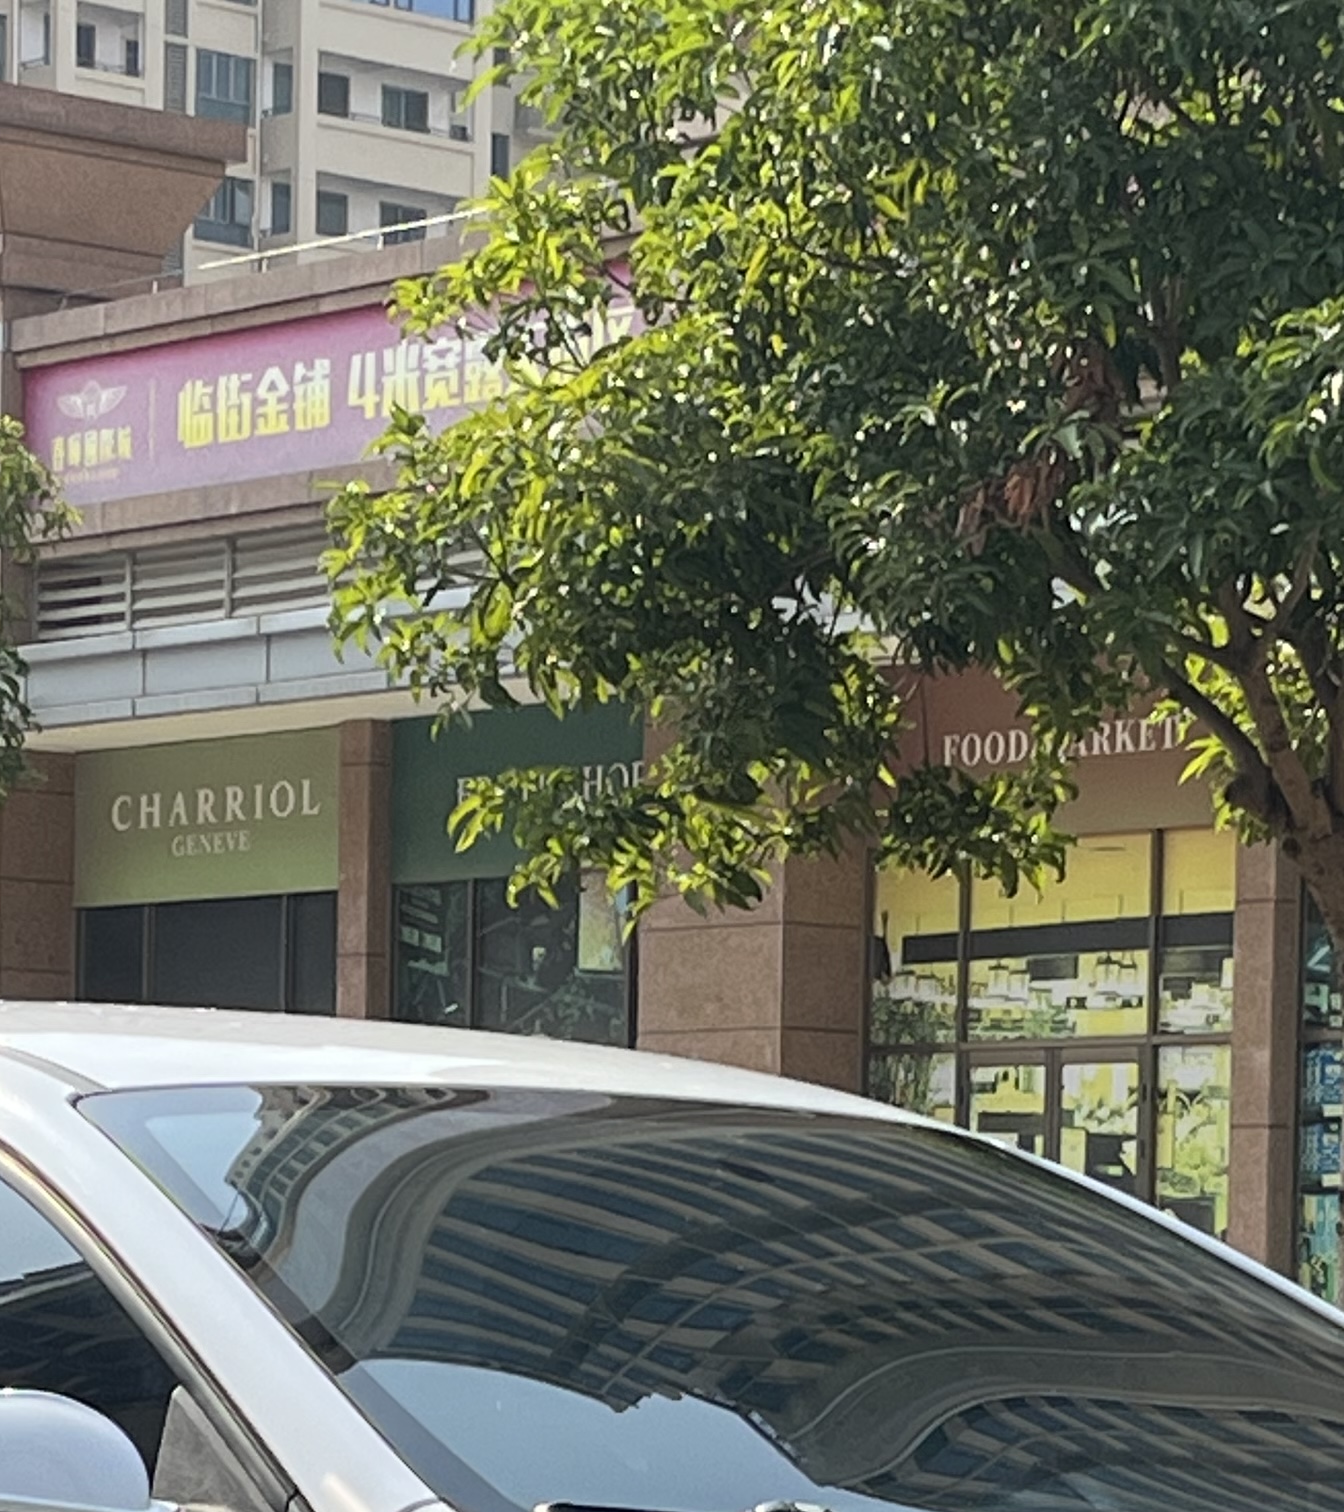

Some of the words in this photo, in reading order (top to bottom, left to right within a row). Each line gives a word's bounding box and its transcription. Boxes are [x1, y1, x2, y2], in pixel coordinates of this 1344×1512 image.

[177, 360, 331, 449] 临街金铺
[943, 729, 1029, 768] FOOD
[1046, 716, 1180, 758] ARKET
[111, 778, 320, 832] CHARRIOL
[171, 830, 250, 856] GENEVE
